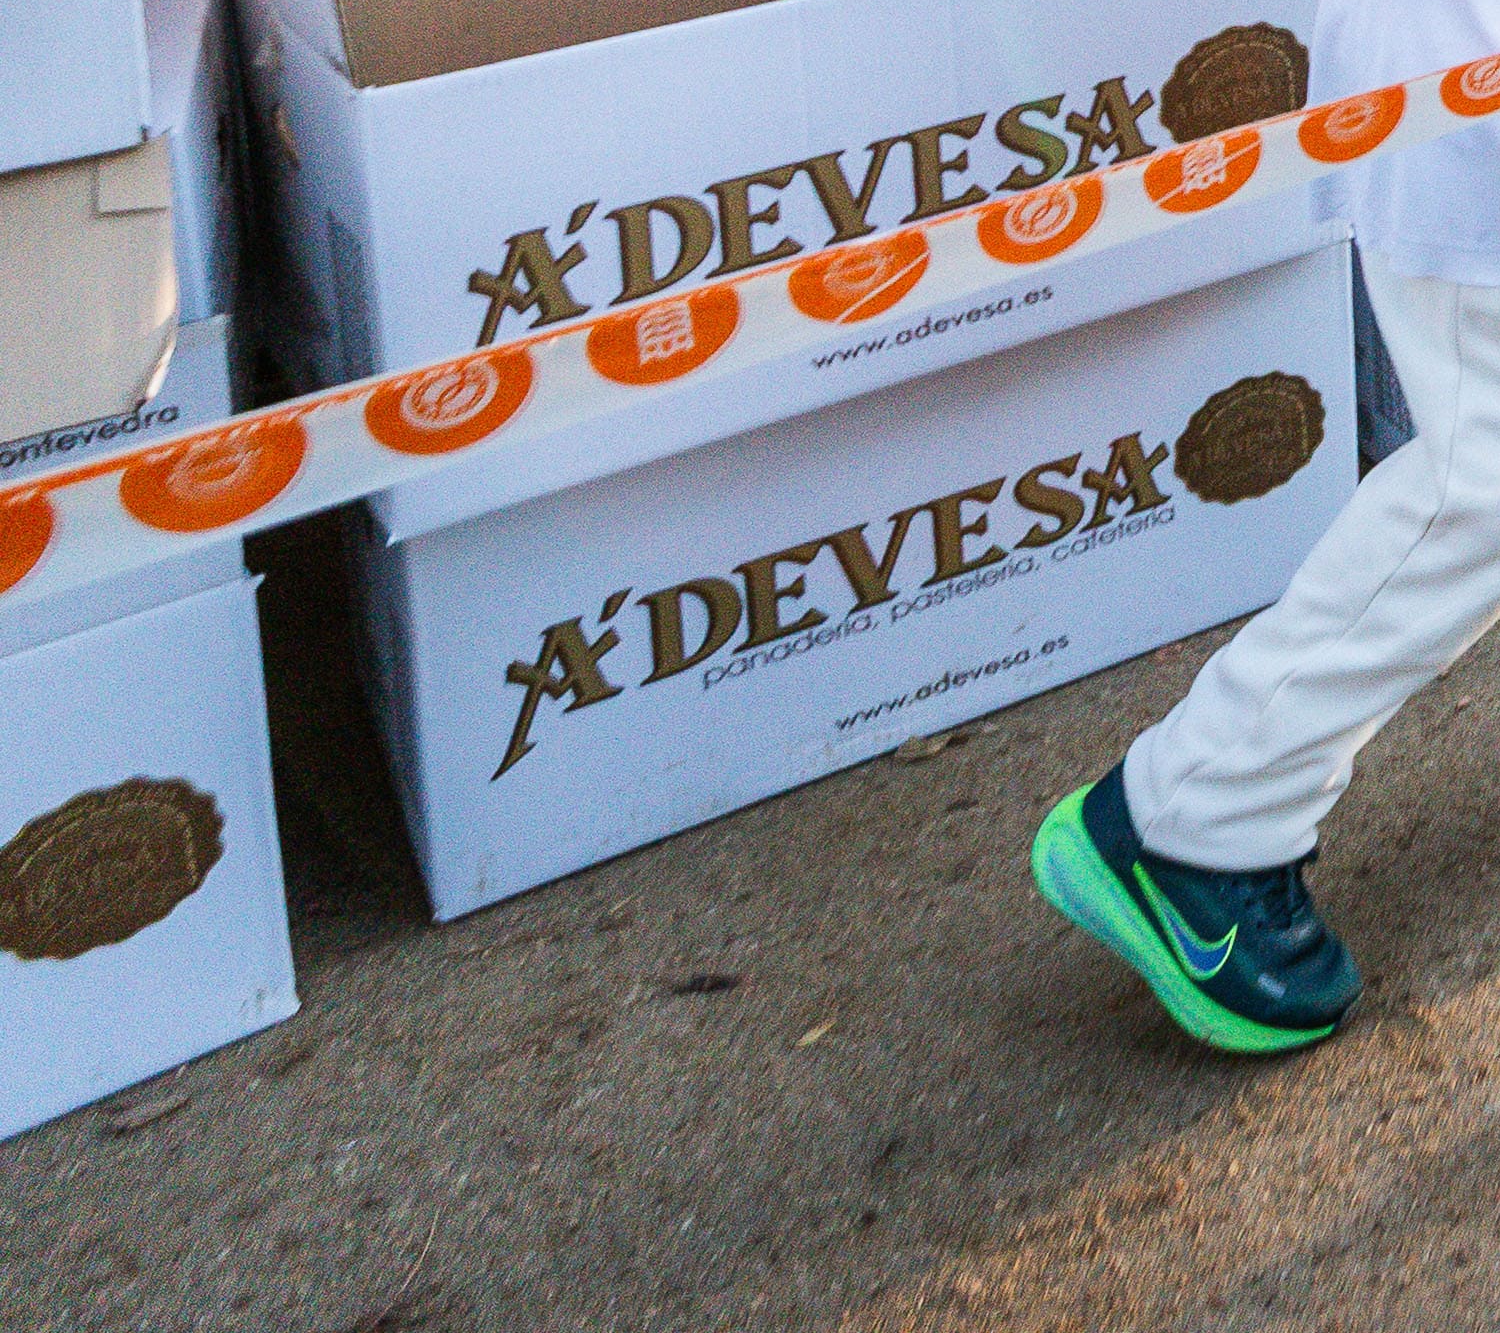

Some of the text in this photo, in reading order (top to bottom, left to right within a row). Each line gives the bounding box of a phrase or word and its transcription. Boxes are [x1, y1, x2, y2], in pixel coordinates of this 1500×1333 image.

[812, 283, 1055, 371] www.adevesa.es
[0, 397, 179, 468] ontevedra
[834, 633, 1071, 732] www.adevesa.es
